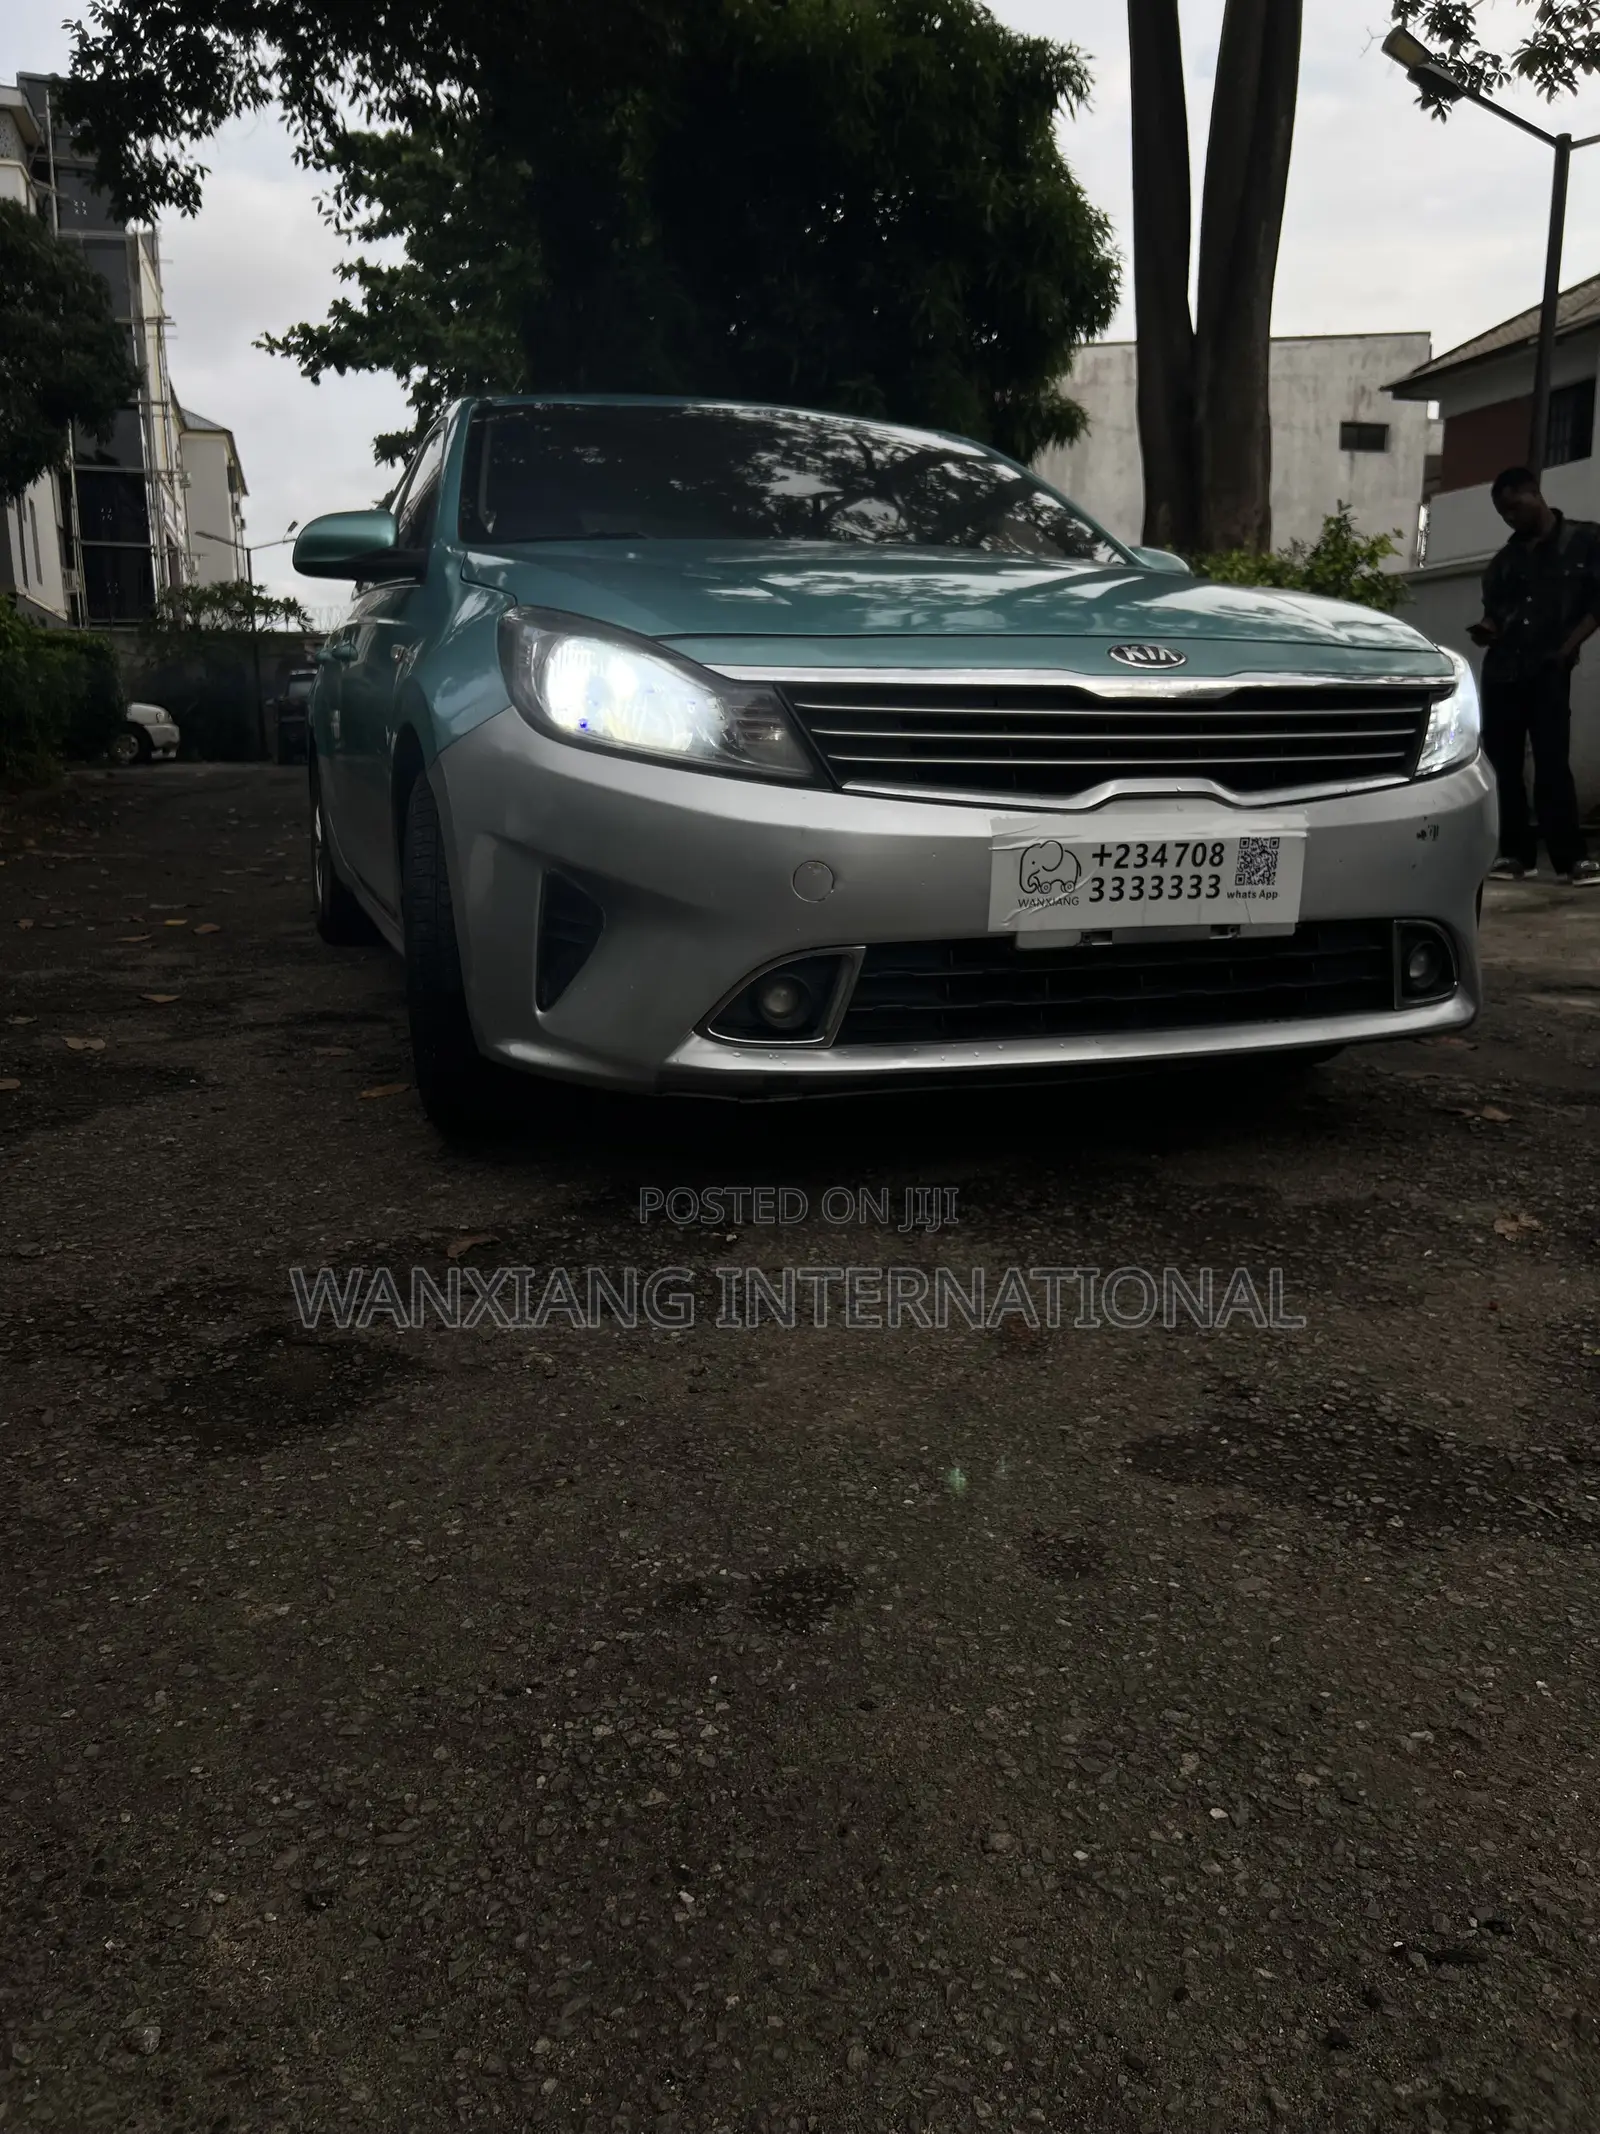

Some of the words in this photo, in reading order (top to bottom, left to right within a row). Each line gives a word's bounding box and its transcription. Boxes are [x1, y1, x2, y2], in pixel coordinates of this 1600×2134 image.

[1120, 646, 1179, 662] KIA
[1091, 842, 1225, 869] +234708
[1089, 874, 1221, 903] 3333333
[1258, 889, 1278, 901] App
[1017, 896, 1080, 908] WANXIANG
